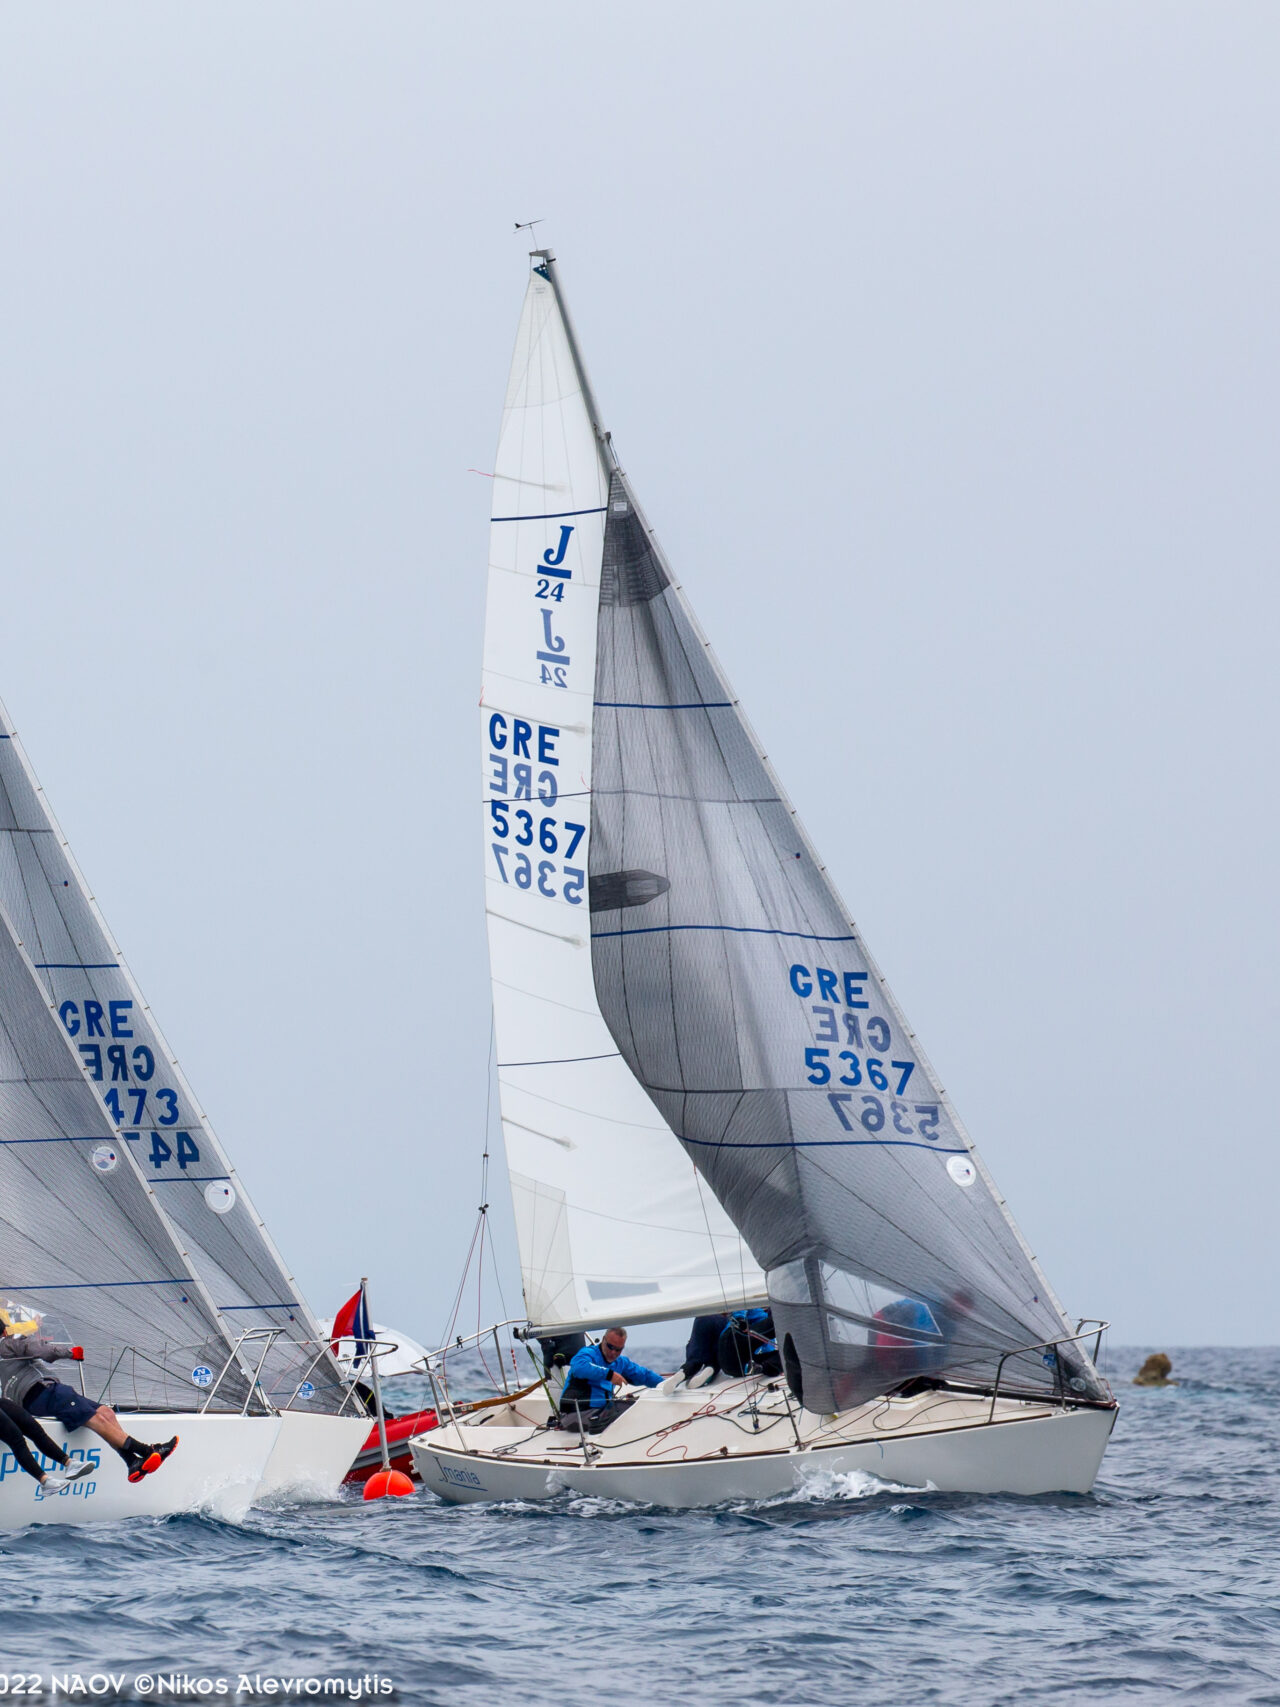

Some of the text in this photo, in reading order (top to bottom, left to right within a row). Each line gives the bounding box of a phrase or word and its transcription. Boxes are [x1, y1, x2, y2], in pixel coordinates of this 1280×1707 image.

[543, 525, 574, 566] J
[534, 579, 565, 602] 24
[489, 713, 560, 766] GRE
[490, 799, 586, 860] 5367
[789, 963, 870, 1009] GRE
[58, 1000, 134, 1038] GRE
[804, 1047, 915, 1096] 5367
[104, 1088, 180, 1126] 473
